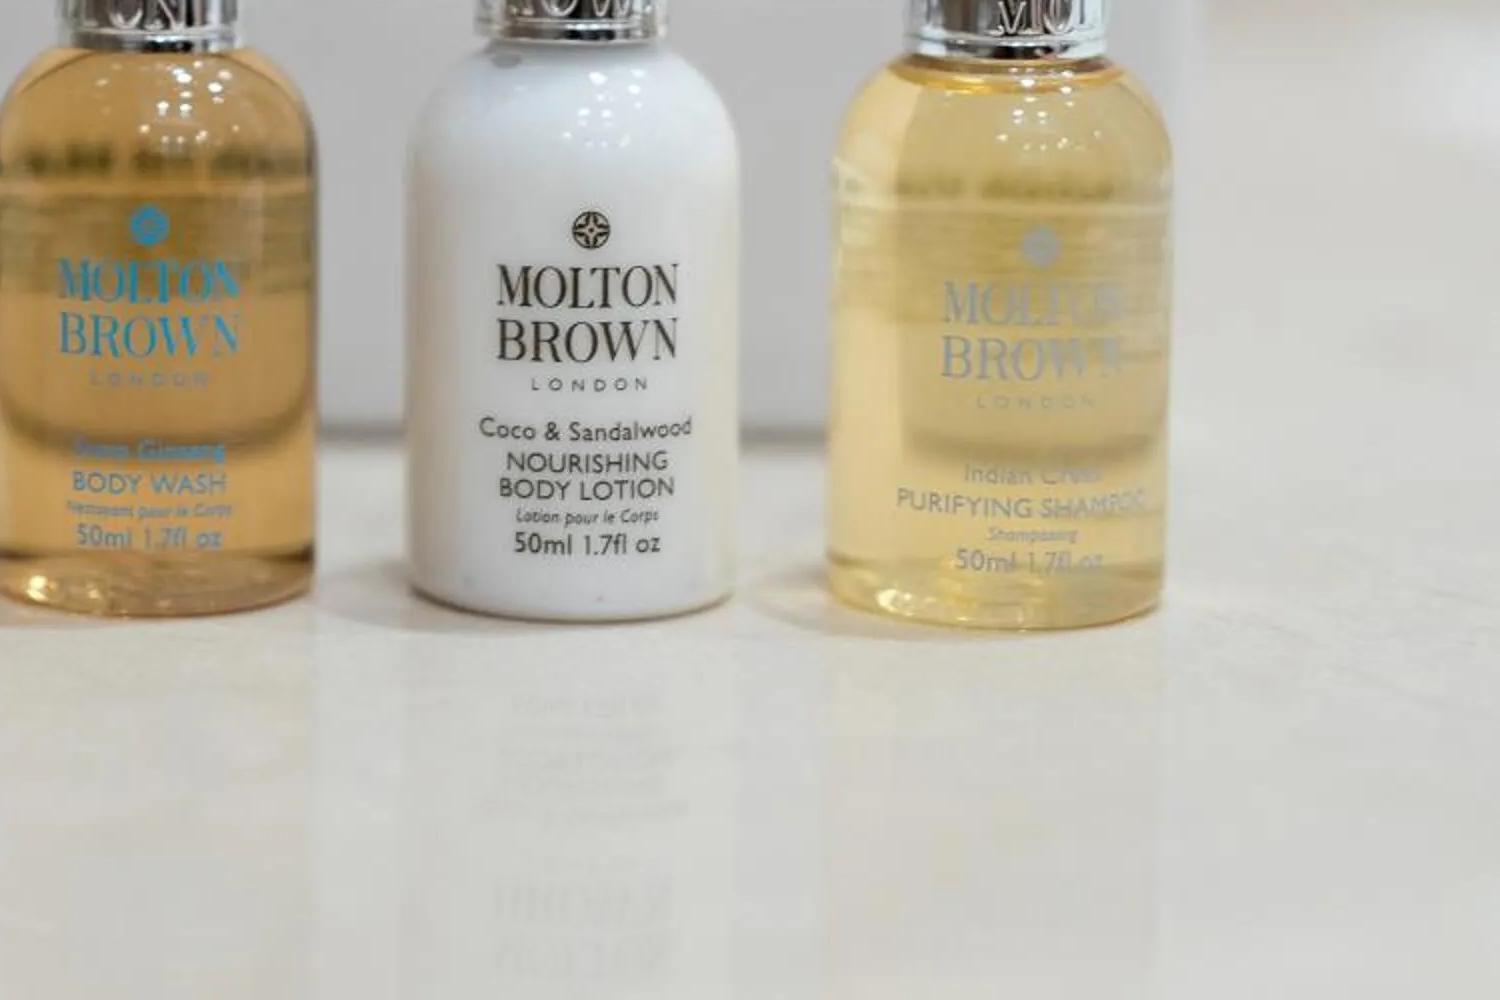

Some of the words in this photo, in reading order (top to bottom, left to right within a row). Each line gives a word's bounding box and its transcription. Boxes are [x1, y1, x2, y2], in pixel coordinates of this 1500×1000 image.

[59, 257, 242, 305] MOLTON
[496, 263, 679, 309] MOLTON
[59, 311, 241, 360] BROWN
[496, 317, 679, 364] BROWN
[89, 371, 211, 387] LONDON
[531, 376, 648, 393] LONDON
[479, 416, 537, 440] Coco
[544, 420, 562, 442] &
[568, 415, 694, 442] Sandalwood
[506, 450, 669, 474] NOURISHING
[963, 462, 1033, 486] Indian
[73, 470, 142, 495] BODY
[150, 473, 227, 496] WASH
[499, 477, 572, 501] BODY
[579, 475, 676, 502] LOTION
[896, 486, 1033, 520] PURIFYING
[516, 507, 561, 524] Lotion
[563, 509, 600, 528] pour
[603, 508, 616, 524] le
[619, 507, 661, 526] Corps
[77, 522, 132, 549] 50ml
[195, 530, 223, 550] oz
[514, 530, 573, 556] 50ml
[583, 531, 627, 556] 1.7fl
[634, 536, 661, 554] oz
[955, 547, 1018, 574] 50ml
